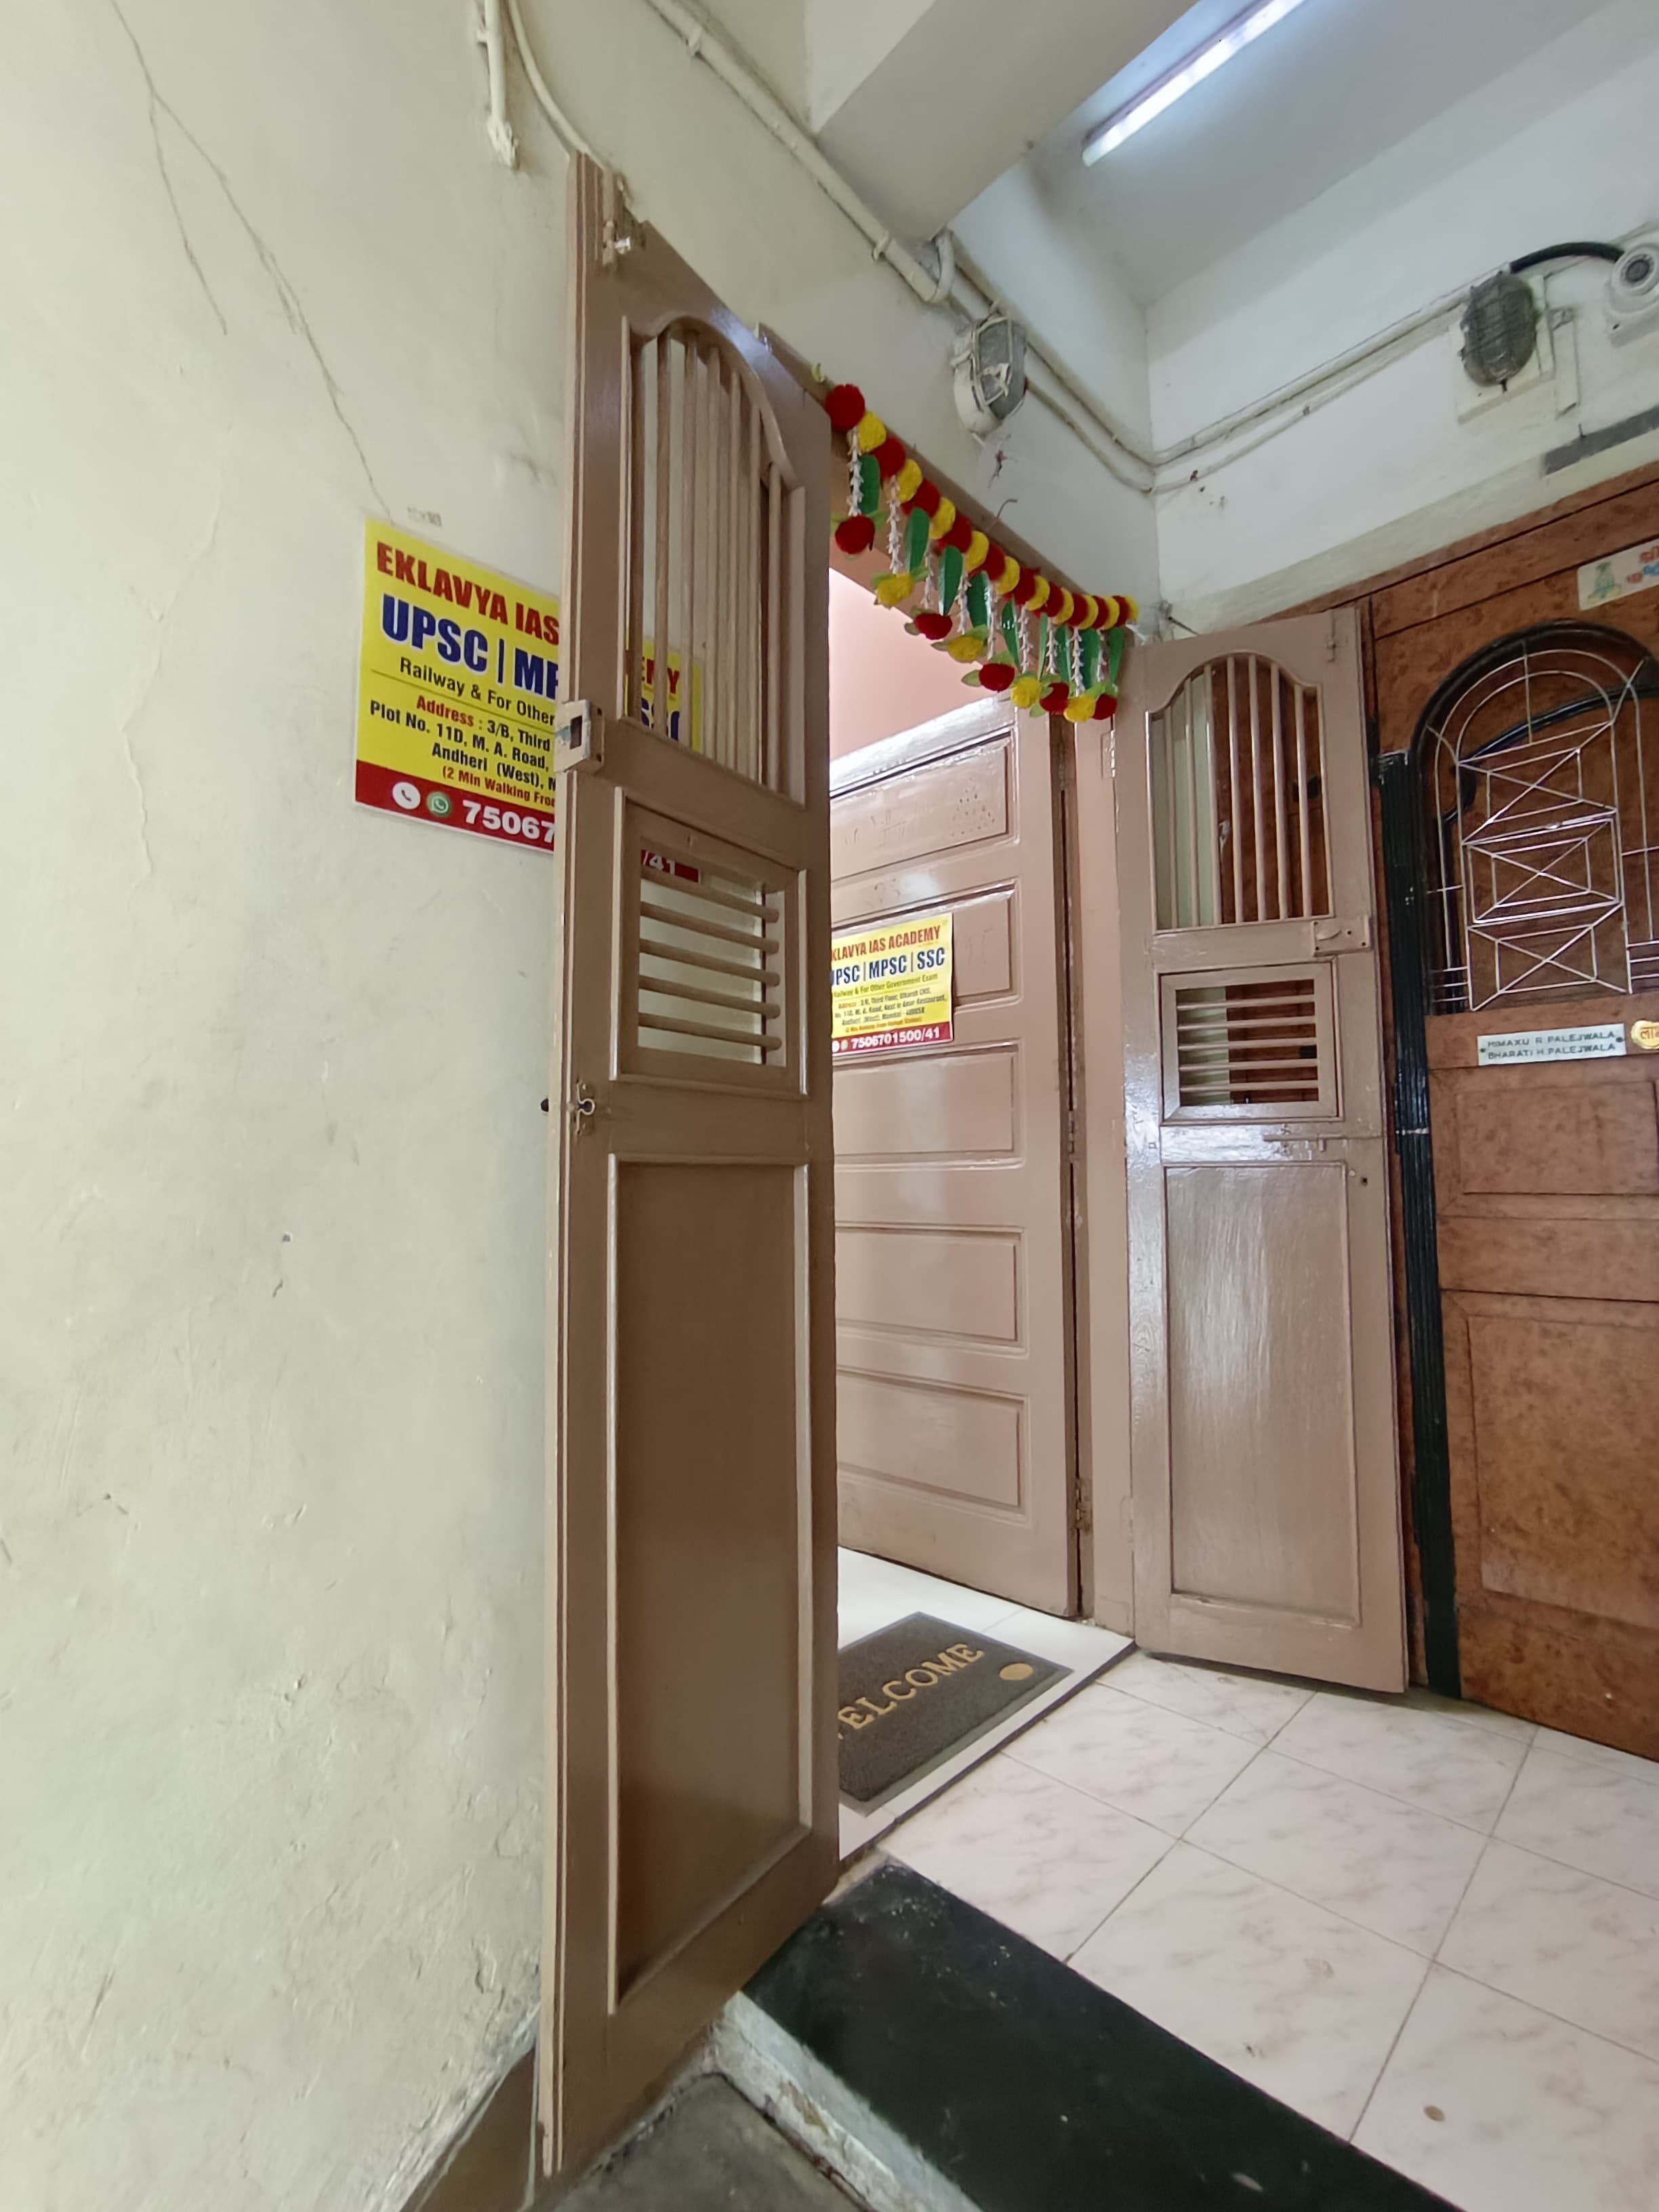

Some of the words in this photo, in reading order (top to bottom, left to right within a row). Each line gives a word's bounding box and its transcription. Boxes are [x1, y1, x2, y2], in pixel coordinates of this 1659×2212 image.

[377, 541, 508, 625] EKLAVYA
[516, 602, 559, 645] IAS
[382, 594, 488, 672] UPSC
[514, 648, 559, 700] MP
[400, 657, 465, 697] Railway
[471, 684, 481, 700] &
[488, 689, 512, 711] For
[517, 700, 555, 726] Other
[371, 699, 401, 724] Plot
[406, 712, 430, 733] No.
[437, 723, 468, 746] 11D,
[472, 734, 489, 752] M.
[494, 741, 508, 758] A.
[512, 747, 549, 772] Road,
[416, 695, 474, 727] Address
[487, 720, 513, 741] 3/B,
[518, 729, 550, 752] Third
[432, 743, 488, 772] Andheri
[443, 765, 454, 780] (2
[459, 770, 481, 787] Min
[485, 777, 531, 802] Walking
[534, 792, 555, 807] Fro
[462, 799, 554, 844] 75067
[832, 941, 867, 961] KLAVYA
[869, 937, 886, 954] IAS
[888, 925, 941, 950] ACADEMY
[869, 954, 907, 979] MPSC
[917, 947, 945, 970] SSC
[851, 1027, 941, 1050] 7506701500/41
[838, 1643, 985, 1729] ELCOME
